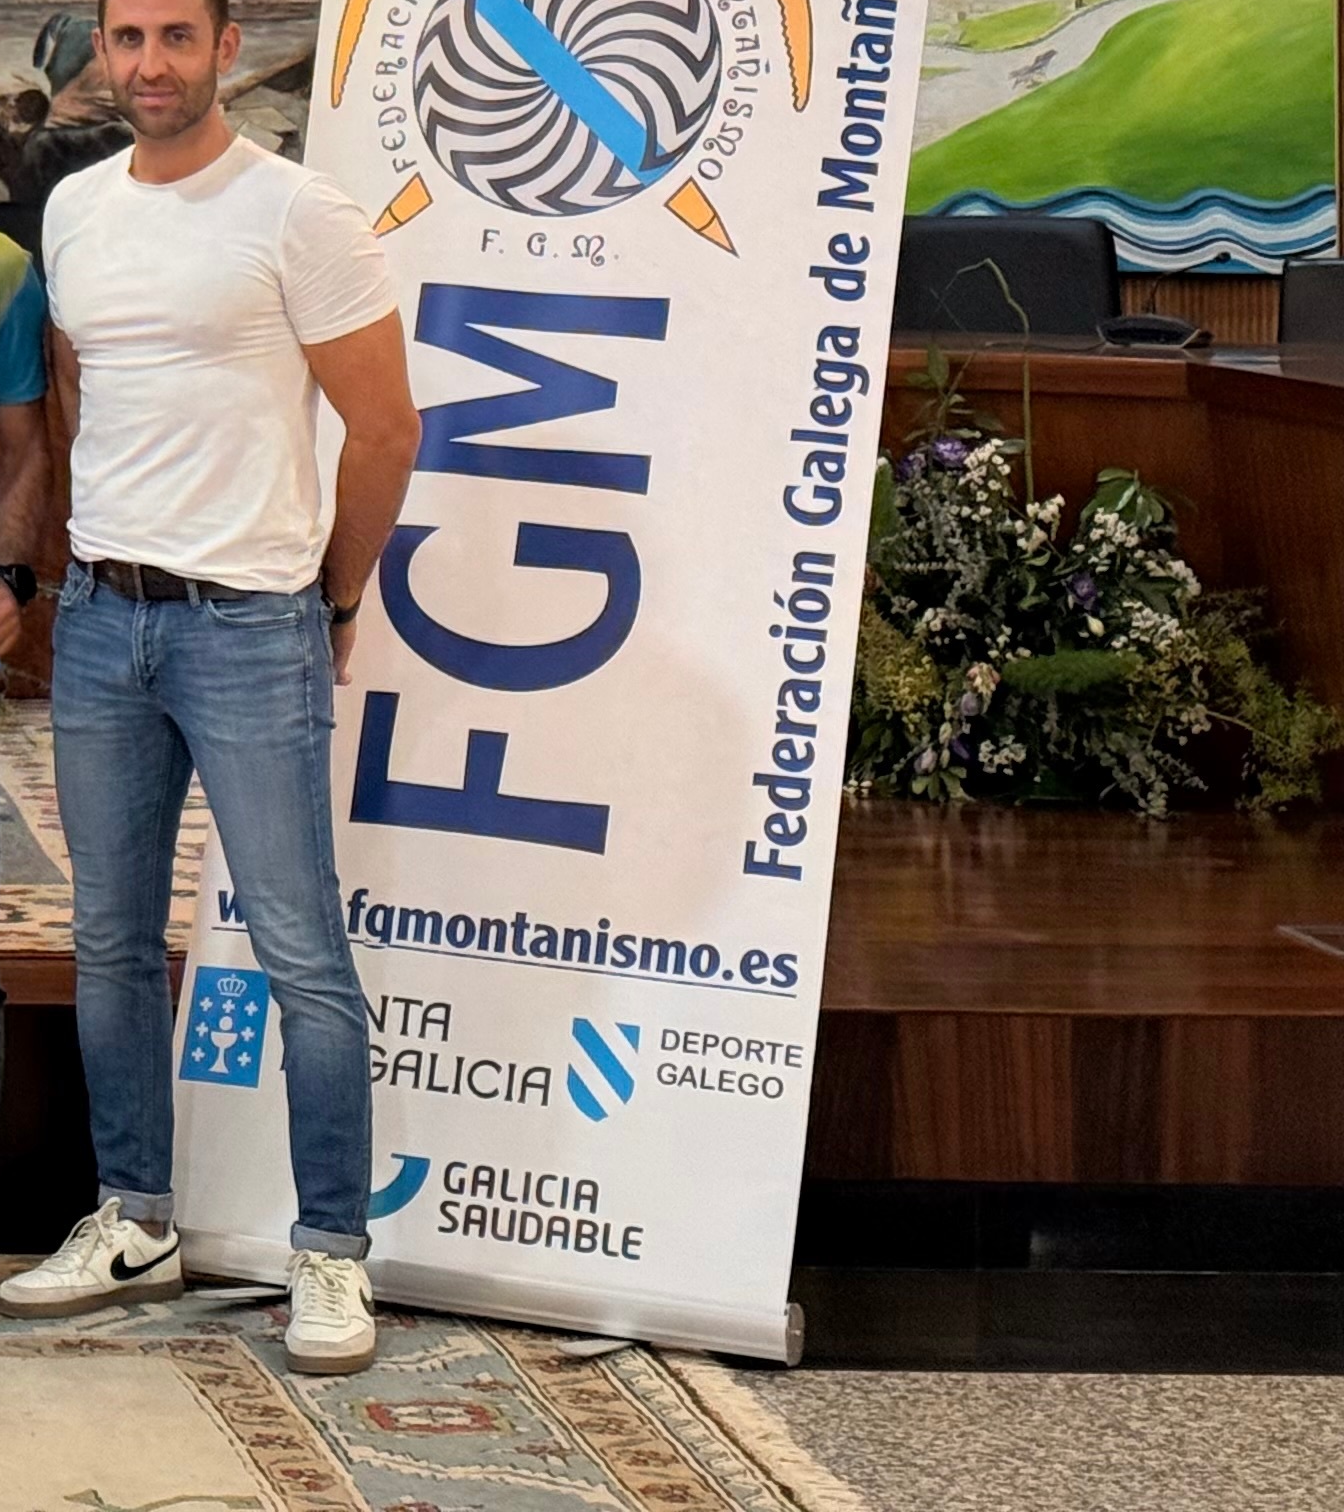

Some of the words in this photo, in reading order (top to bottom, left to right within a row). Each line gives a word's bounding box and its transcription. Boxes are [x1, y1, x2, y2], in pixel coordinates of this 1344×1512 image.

[809, 231, 871, 304] de
[783, 325, 870, 527] Galega
[349, 282, 670, 855] FGM
[742, 549, 837, 882] Federación
[218, 888, 799, 989] wfgmontanismo.es
[366, 994, 452, 1044] NTA
[659, 1028, 805, 1069] DEPORTE
[656, 1062, 786, 1101] GALEGO
[443, 1162, 600, 1214] GALICIA
[437, 1200, 644, 1261] SAUDABLE
